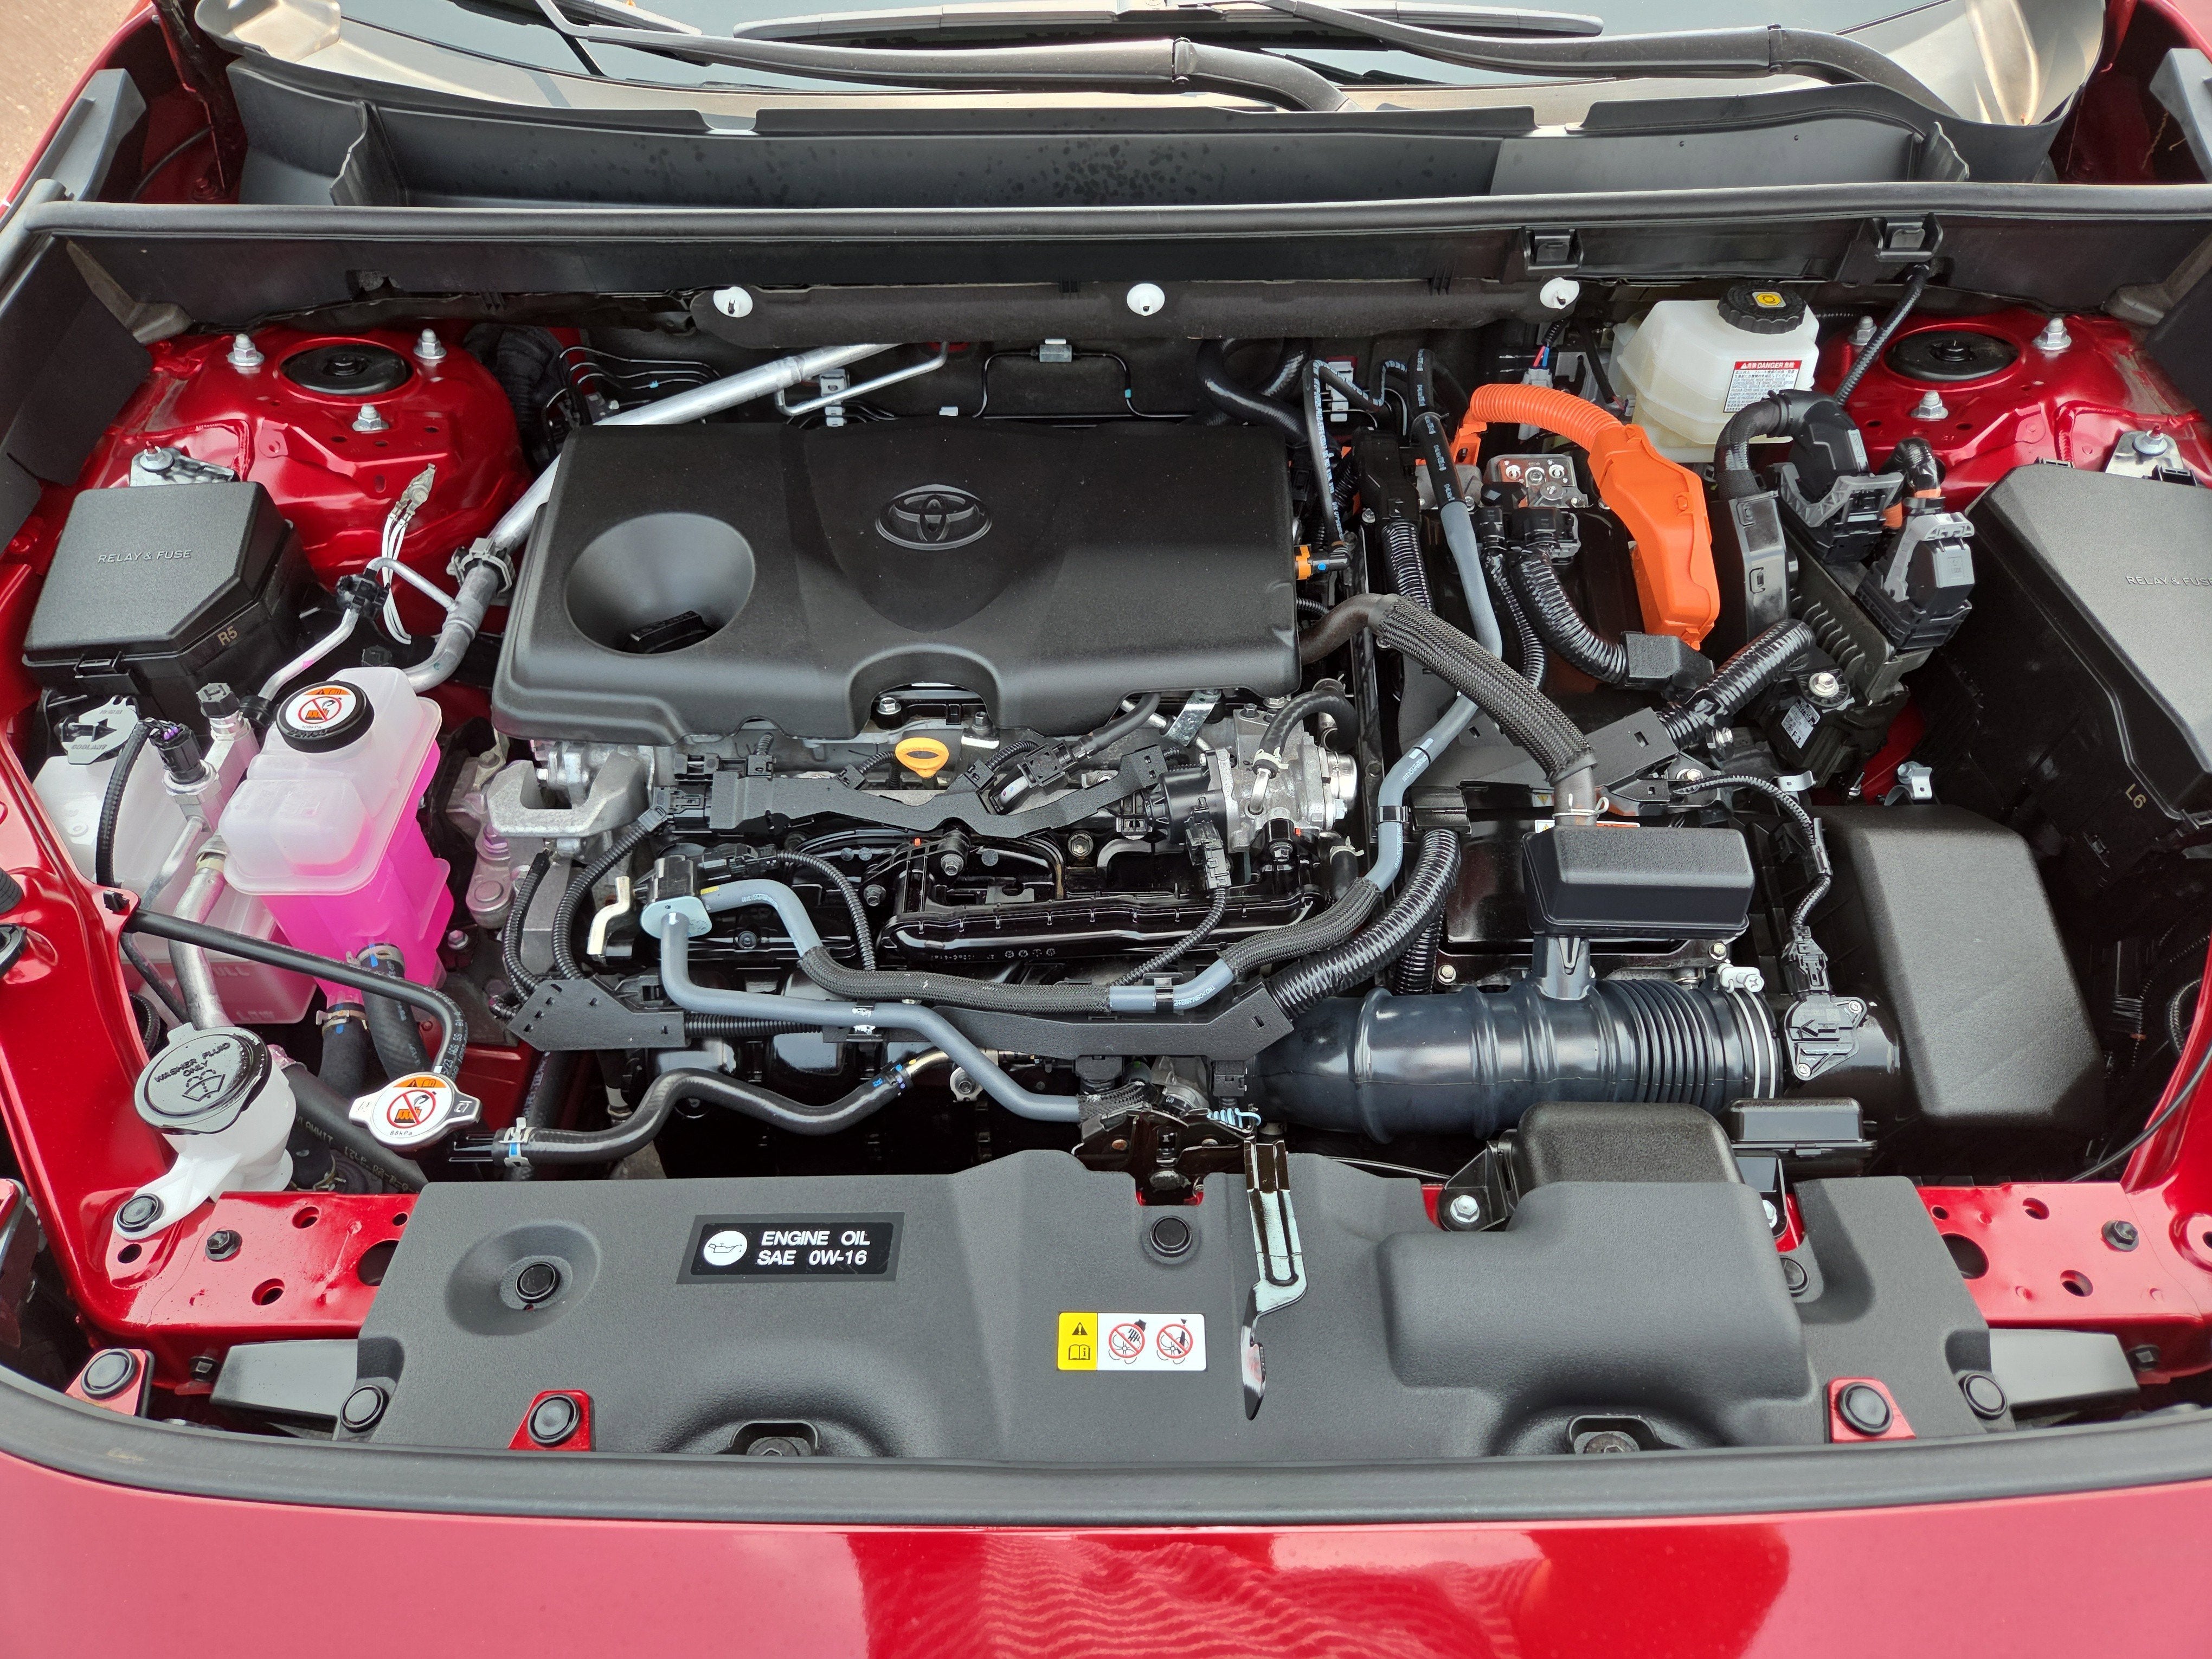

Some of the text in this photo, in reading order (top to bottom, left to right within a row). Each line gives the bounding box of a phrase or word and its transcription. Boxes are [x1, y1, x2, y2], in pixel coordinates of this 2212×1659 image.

[98, 550, 192, 564] RELAY & FUSE
[2125, 576, 2168, 586] RELAY
[2171, 577, 2181, 586] &
[217, 626, 237, 646] R5
[2125, 783, 2146, 808] L6
[154, 1042, 230, 1082] WASHER FLUID
[183, 1060, 208, 1077] ONLY
[761, 1230, 871, 1246] ENGINE OIL
[757, 1249, 867, 1266] SAE 0W-16
